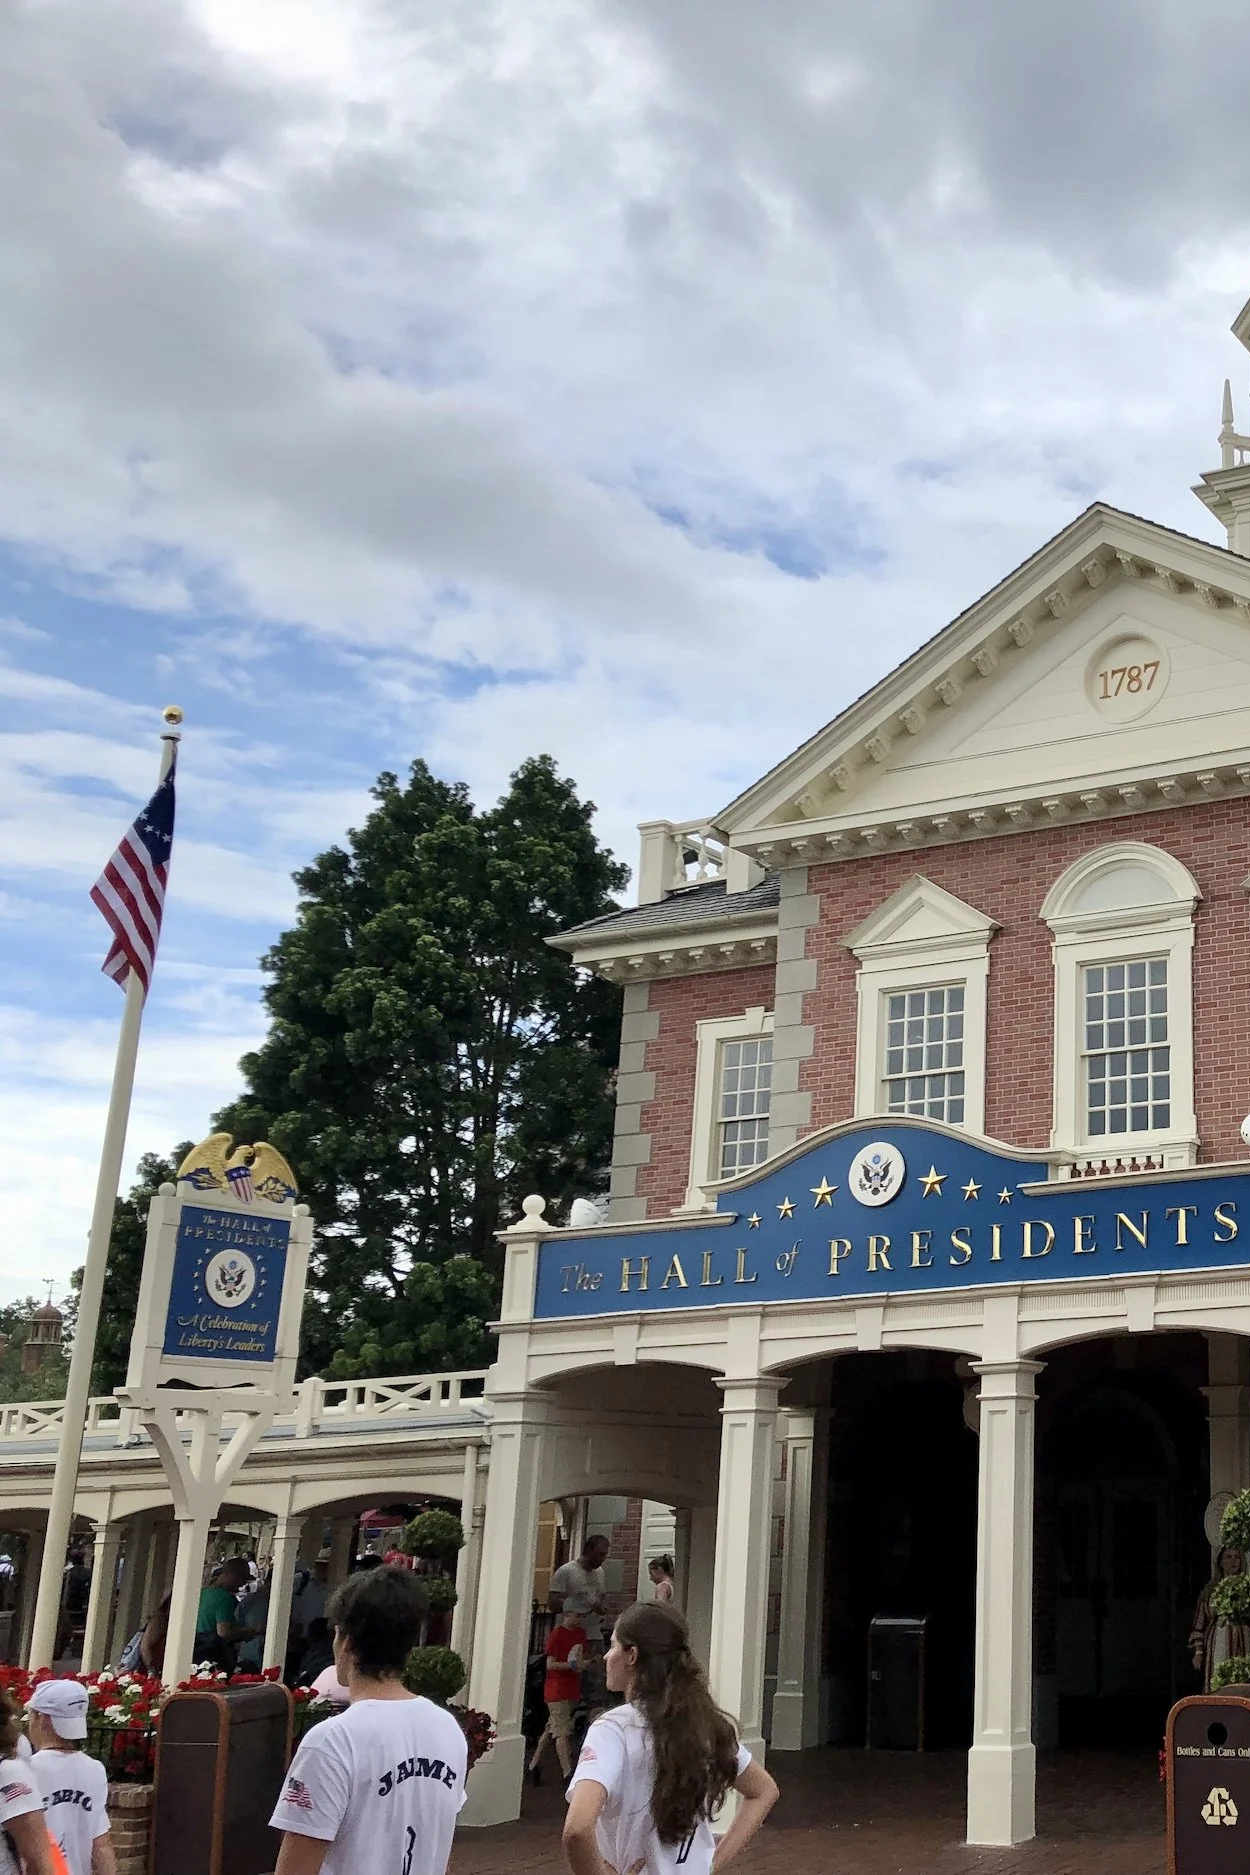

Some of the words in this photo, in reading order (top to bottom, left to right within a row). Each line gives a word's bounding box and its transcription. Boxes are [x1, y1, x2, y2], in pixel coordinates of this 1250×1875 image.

[1098, 660, 1161, 700] 1787
[203, 1215, 217, 1225] The
[220, 1217, 260, 1233] HALL
[184, 1226, 285, 1250] PRESIDENTS
[560, 1262, 602, 1293] The
[618, 1247, 759, 1293] HALL
[775, 1239, 802, 1278] of
[826, 1201, 1239, 1276] PRESIDENTS
[177, 1314, 199, 1327] A
[200, 1314, 258, 1332] Celebration
[259, 1320, 272, 1336] of
[178, 1332, 224, 1352] Liberty's
[225, 1336, 265, 1353] Leaders
[1176, 1746, 1201, 1757] Bottles
[1202, 1746, 1216, 1757] and
[1217, 1747, 1236, 1757] Cans
[378, 1757, 458, 1797] JAIME
